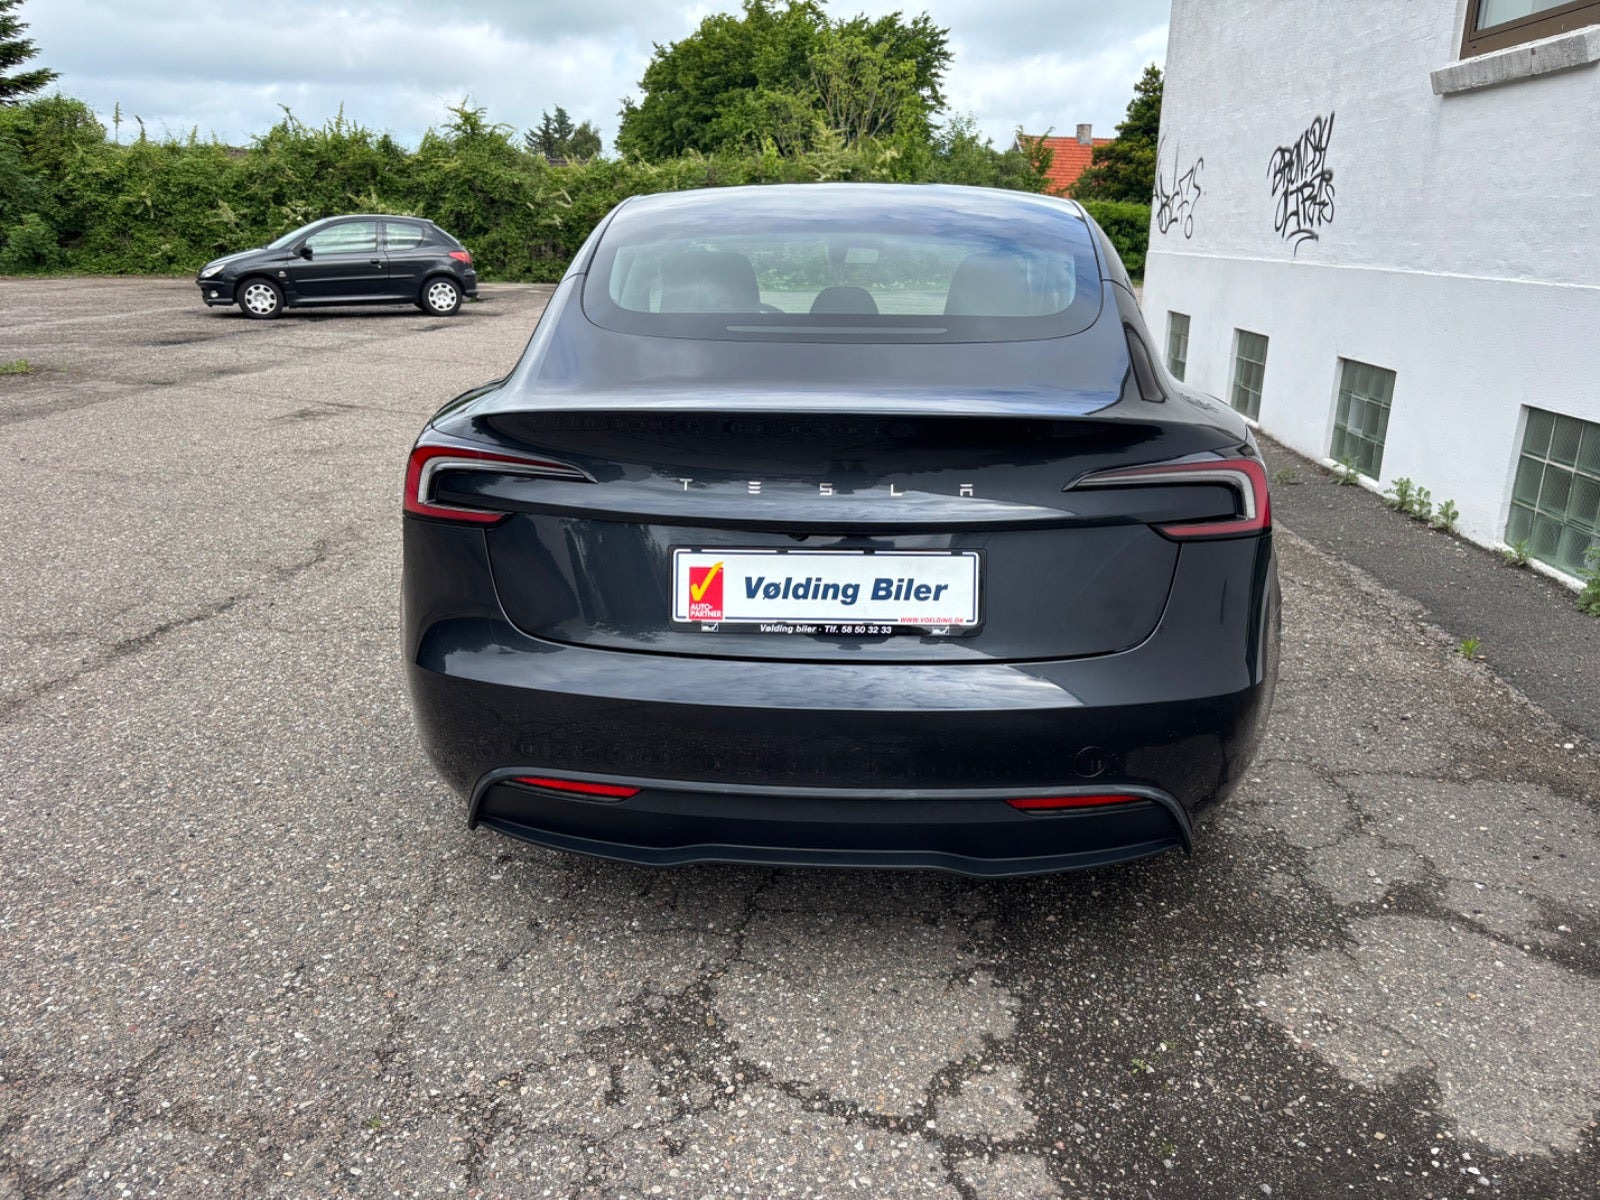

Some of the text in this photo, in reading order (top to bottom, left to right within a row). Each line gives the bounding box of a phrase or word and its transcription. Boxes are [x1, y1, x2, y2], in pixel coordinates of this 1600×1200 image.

[680, 478, 975, 497] TESLA
[745, 576, 949, 605] Vølding Biler
[690, 603, 714, 611] AUTO-
[760, 624, 893, 634] Vølding biler Tlf. 58 50 32 33
